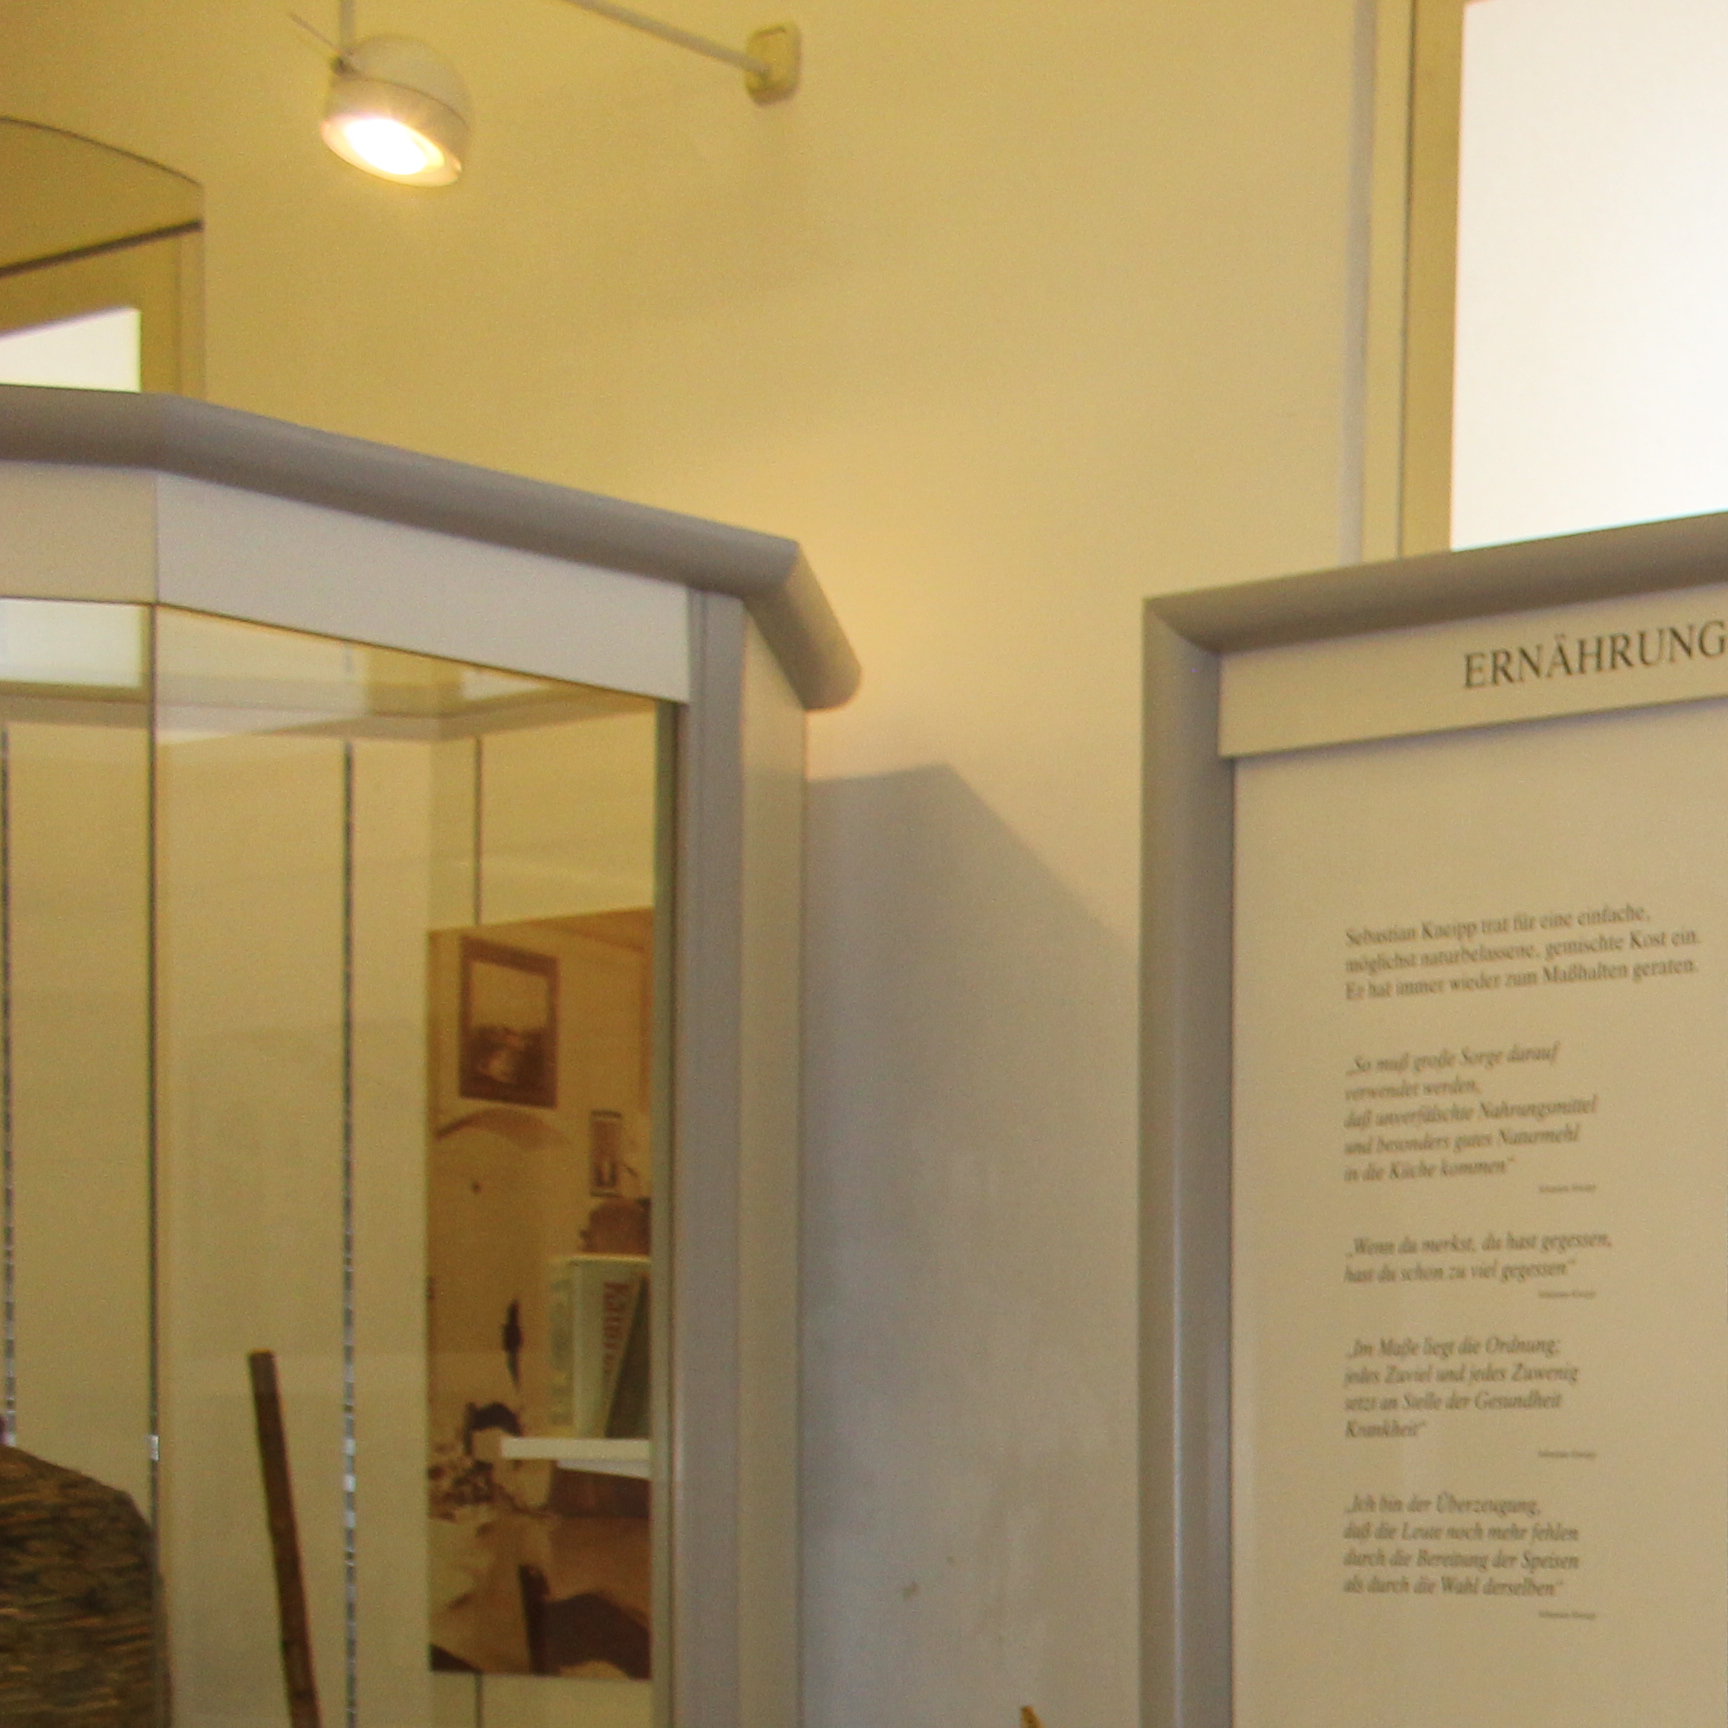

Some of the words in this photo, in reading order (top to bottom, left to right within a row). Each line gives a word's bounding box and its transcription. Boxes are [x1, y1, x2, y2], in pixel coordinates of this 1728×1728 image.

[1346, 928, 1416, 946] Sebastian
[1420, 921, 1476, 941] Kneipp
[1481, 916, 1509, 934] trat
[1513, 913, 1535, 932] für
[1540, 911, 1573, 929] eine
[1368, 981, 1391, 998] hat
[1396, 979, 1444, 997] immer
[1449, 974, 1500, 992] wieder
[1505, 973, 1537, 988] zum
[1542, 964, 1627, 984] Maßhalten
[1633, 958, 1699, 982] geraten.
